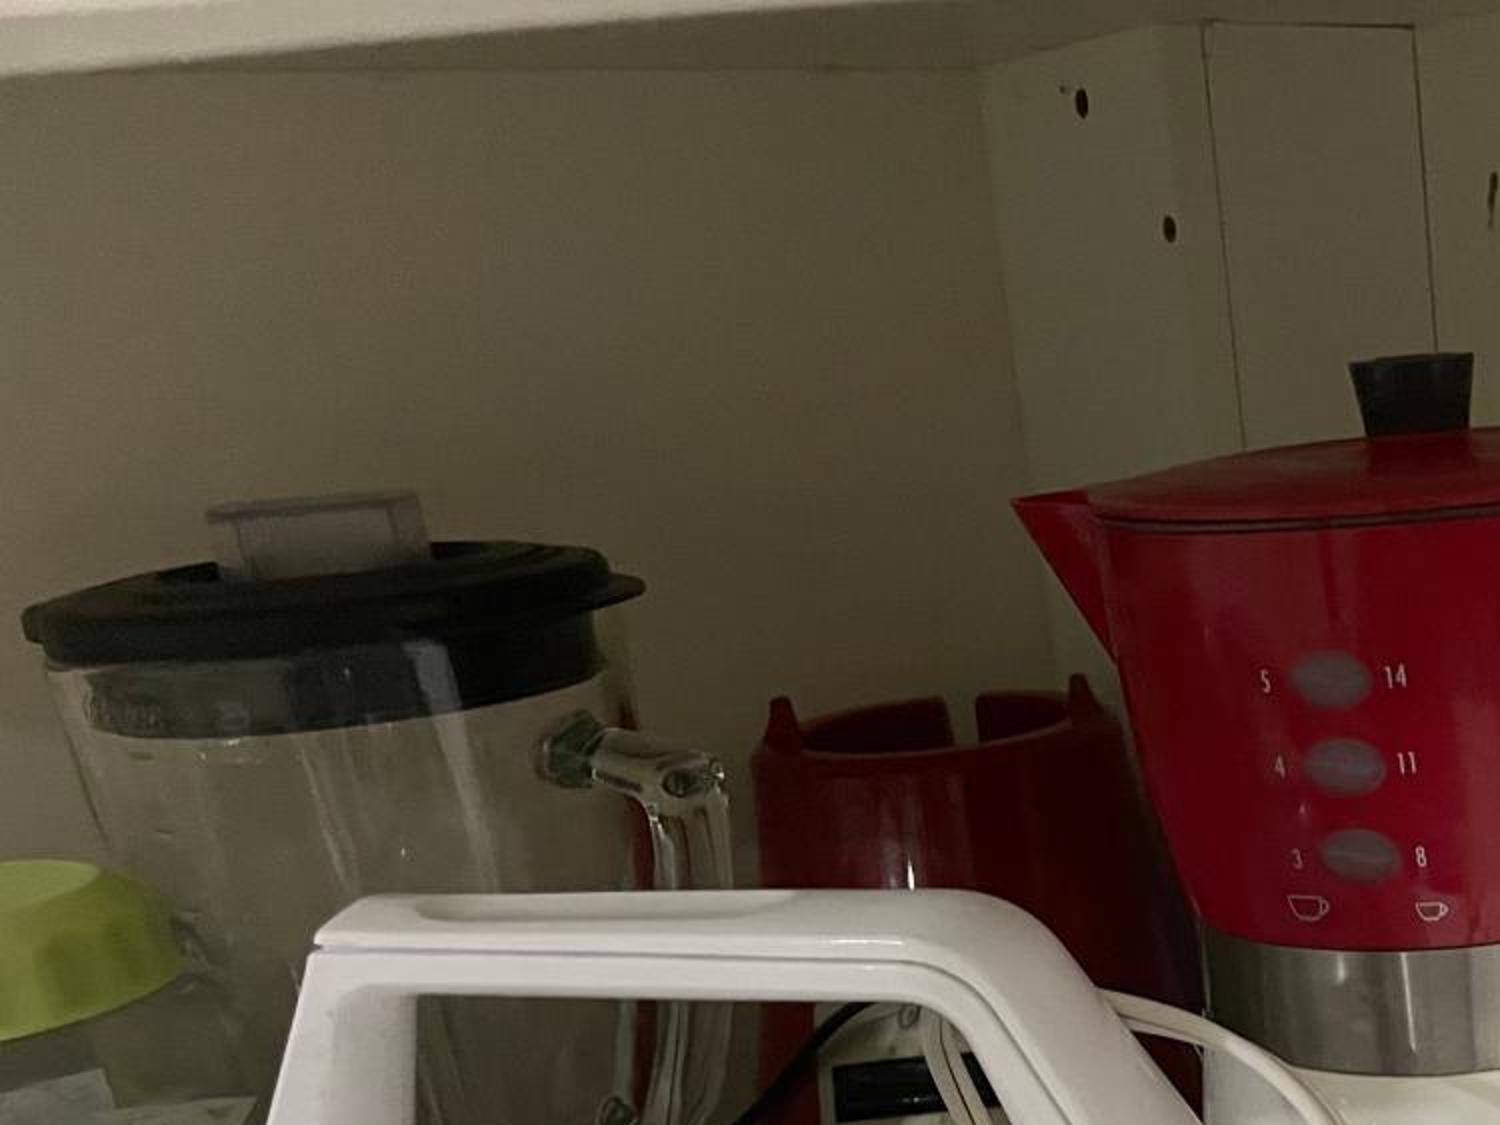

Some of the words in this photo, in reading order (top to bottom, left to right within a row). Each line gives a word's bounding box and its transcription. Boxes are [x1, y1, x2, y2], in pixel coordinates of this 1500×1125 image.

[1260, 669, 1271, 693] 5
[1385, 663, 1407, 689] 14
[1274, 755, 1286, 778] 4
[1397, 751, 1417, 775] 11
[1291, 848, 1303, 869] 3
[1415, 846, 1427, 867] 8
